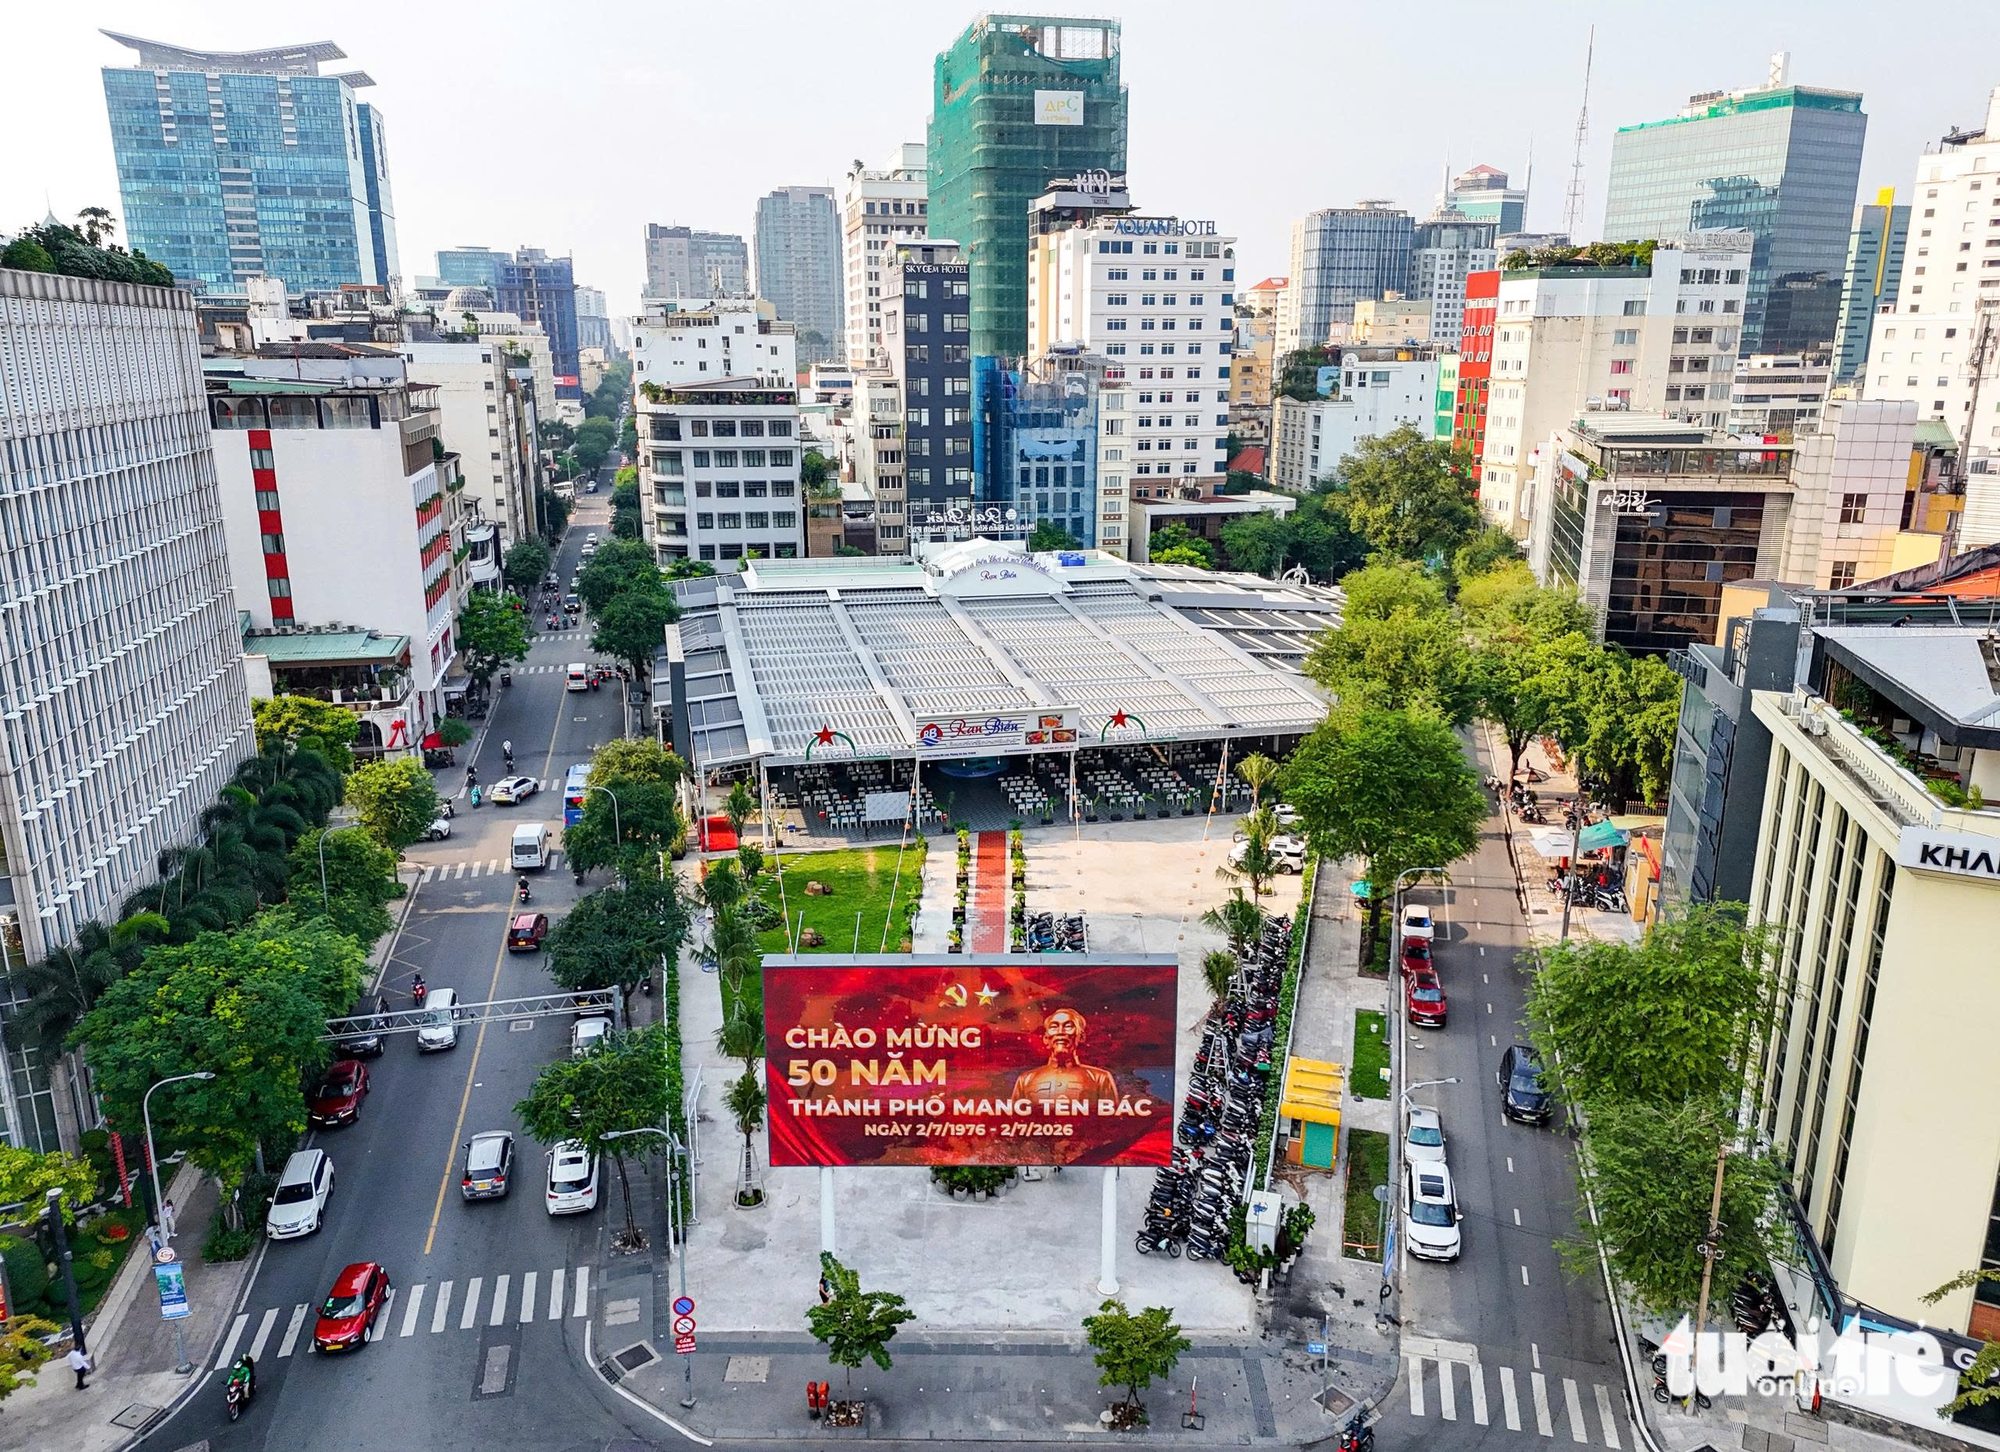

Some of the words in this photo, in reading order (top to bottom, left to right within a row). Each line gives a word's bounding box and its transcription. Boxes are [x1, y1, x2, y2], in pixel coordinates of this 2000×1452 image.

[1044, 96, 1079, 113] APC
[1114, 219, 1171, 236] AQUARI
[1175, 220, 1218, 236] HOTEL
[941, 265, 968, 274] HOTEL
[924, 728, 937, 738] RB
[1920, 842, 2000, 874] KHA
[785, 1022, 877, 1049] CHÀO
[886, 1022, 981, 1049] MỪNG
[787, 1059, 837, 1087] 50
[850, 1052, 947, 1086] NĂM
[787, 1093, 881, 1117] THÀNH
[888, 1092, 945, 1117] PHỐ
[952, 1098, 1032, 1117] MANG
[1039, 1093, 1089, 1116] TÊN
[1097, 1093, 1153, 1116] BÁC
[864, 1121, 911, 1137] NGÀY
[915, 1123, 986, 1138] 2/7/1976
[1000, 1123, 1074, 1137] 2/7/2026
